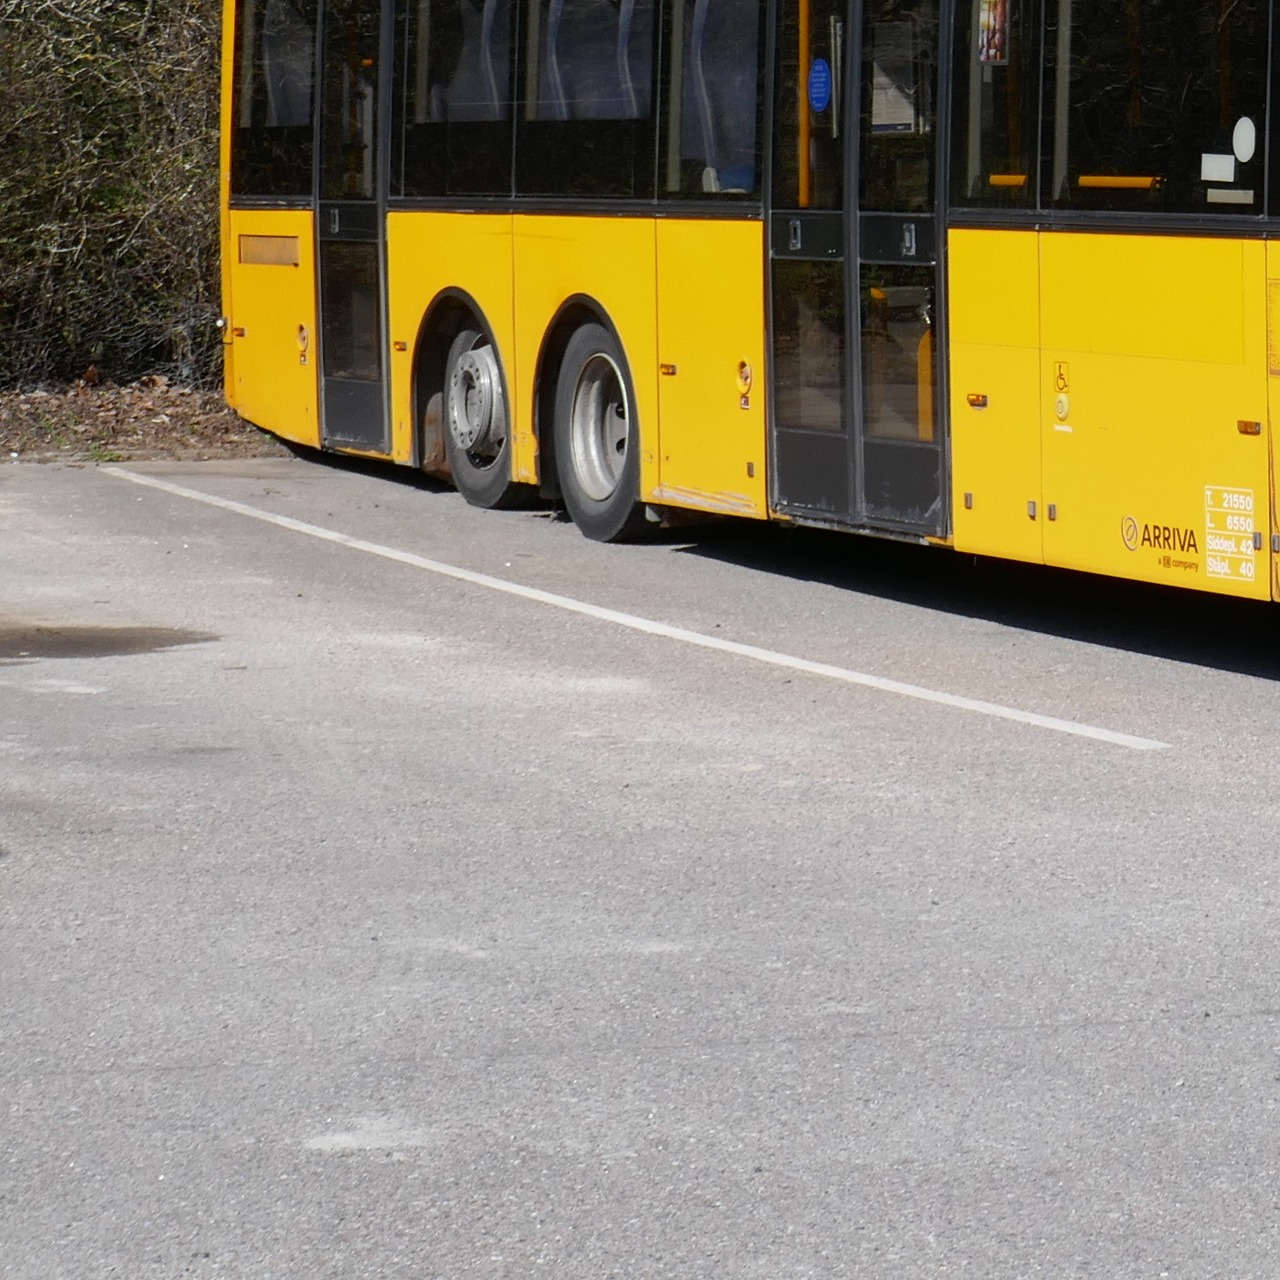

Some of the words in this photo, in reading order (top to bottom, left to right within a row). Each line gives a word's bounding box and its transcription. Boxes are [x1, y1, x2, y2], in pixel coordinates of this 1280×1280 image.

[1222, 493, 1252, 510] 21550
[1226, 515, 1252, 532] 6550
[1141, 523, 1199, 554] ARRIVA
[1240, 539, 1253, 555] 42
[1171, 559, 1199, 573] company
[1240, 561, 1253, 577] 40
